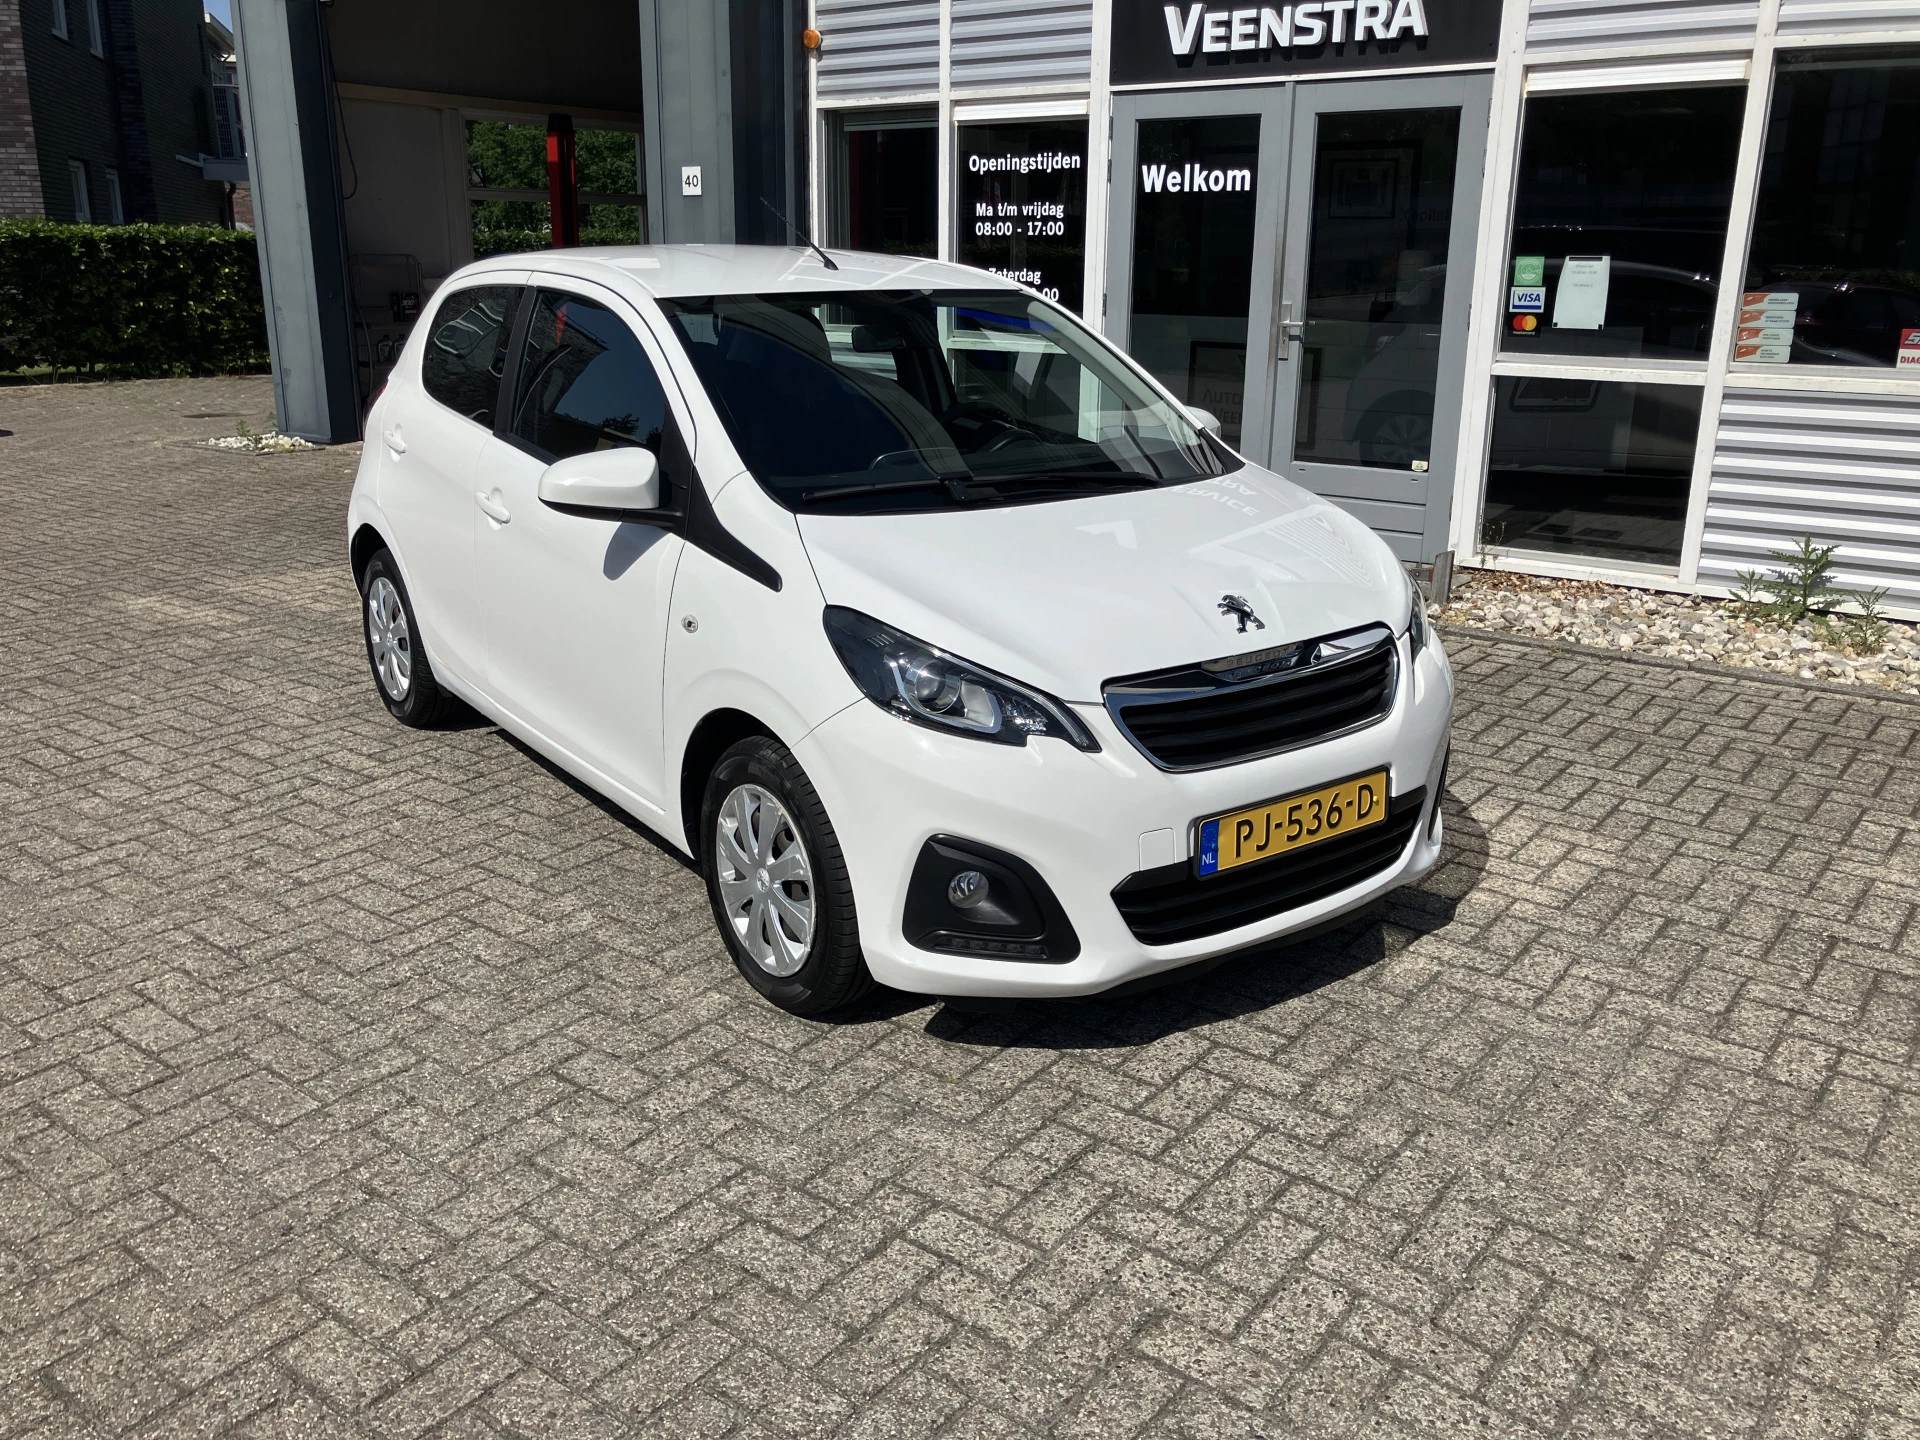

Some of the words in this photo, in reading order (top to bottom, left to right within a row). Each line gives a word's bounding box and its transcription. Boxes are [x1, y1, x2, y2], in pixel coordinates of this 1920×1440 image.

[1164, 0, 1427, 54] VEENSTRA
[969, 152, 1081, 175] Openingstijden
[685, 174, 699, 187] 40
[1142, 163, 1251, 192] Welkom
[976, 203, 993, 216] Ma
[998, 202, 1017, 216] t/m
[1022, 202, 1064, 218] vrijdag
[975, 222, 1012, 236] 08:00
[1027, 221, 1064, 236] 17:00
[1517, 293, 1541, 303] VISA
[1226, 647, 1289, 668] PEUGEOT
[1234, 783, 1375, 859] PJ-536-D
[1201, 852, 1216, 866] NL
